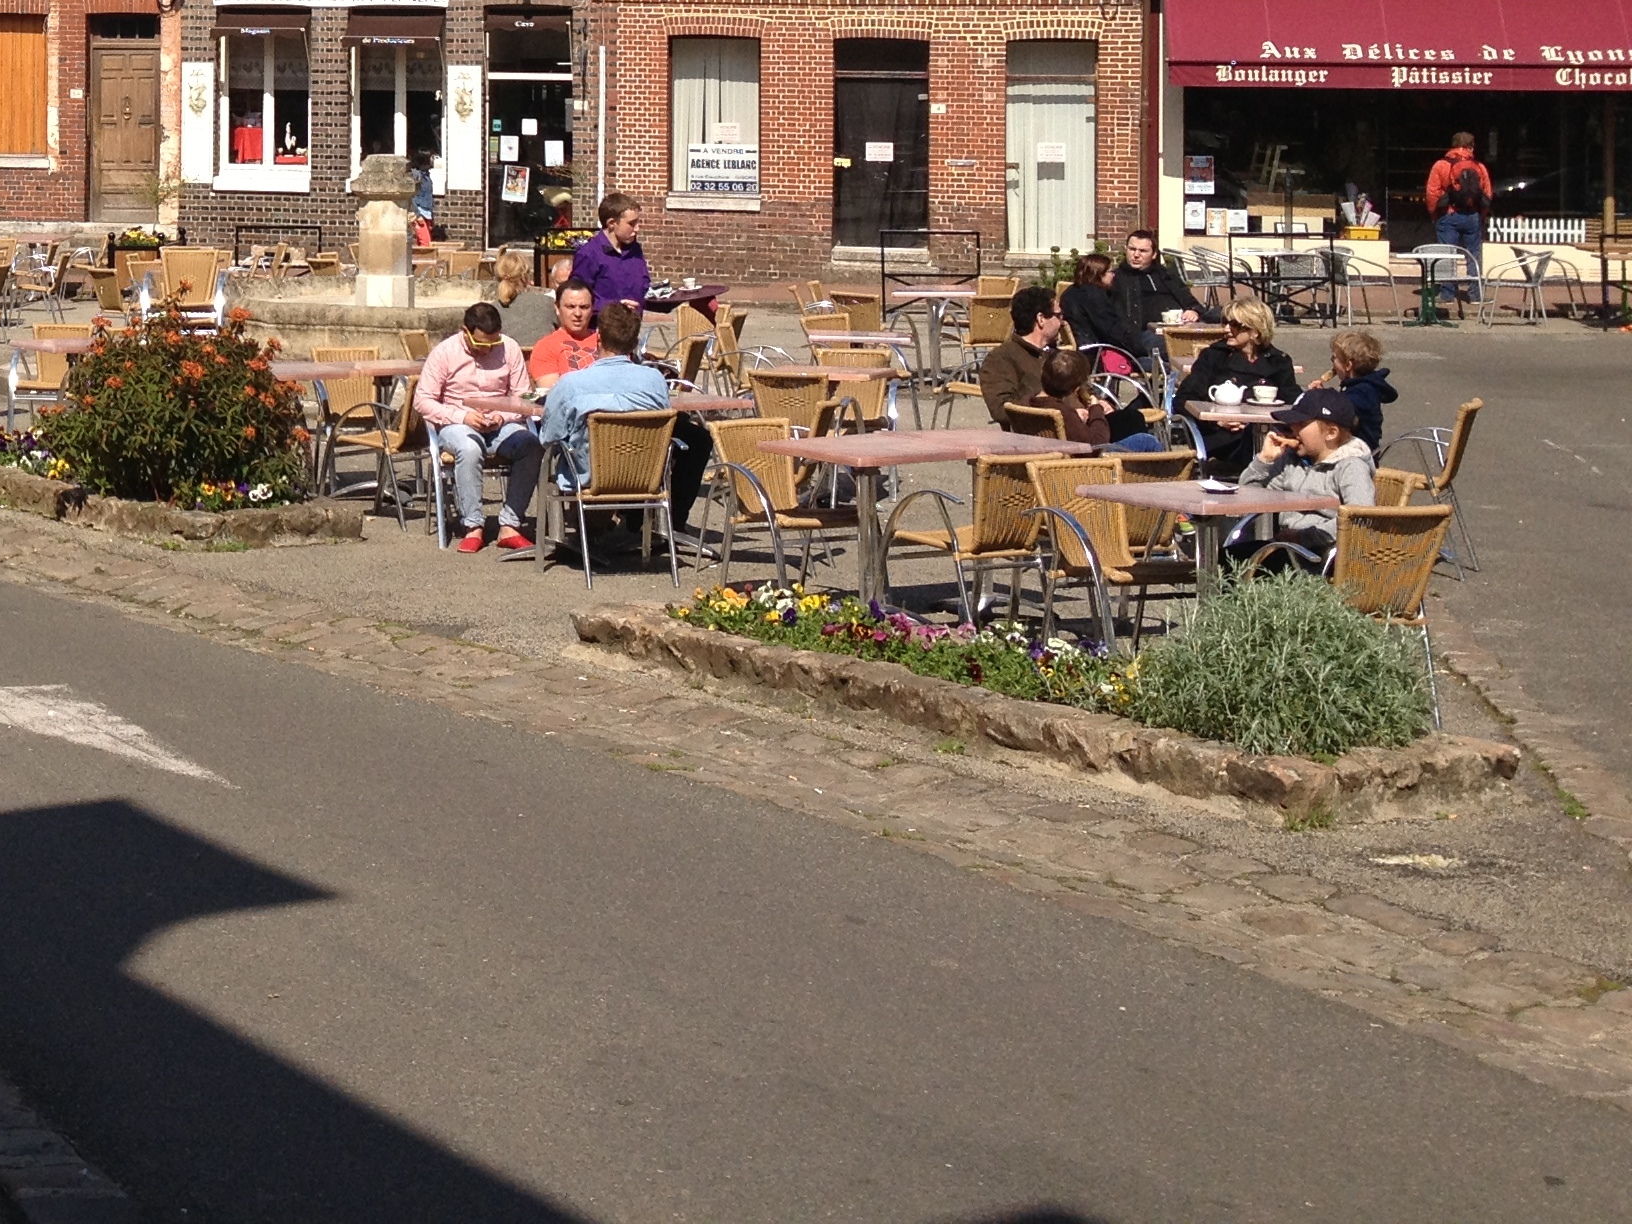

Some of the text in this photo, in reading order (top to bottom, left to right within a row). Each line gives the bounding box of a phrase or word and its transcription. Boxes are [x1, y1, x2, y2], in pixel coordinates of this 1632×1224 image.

[514, 20, 535, 28] Cave
[1259, 40, 1317, 59] Aux
[1341, 42, 1456, 60] Délices
[1482, 43, 1516, 61] de
[1215, 65, 1329, 87] Boulanger
[1391, 66, 1493, 88] Pâtissier
[690, 158, 757, 170] AGENCE LEBLANC
[690, 182, 702, 190] 02
[704, 182, 716, 190] 32
[718, 182, 730, 191] 55
[746, 183, 758, 192] 20
